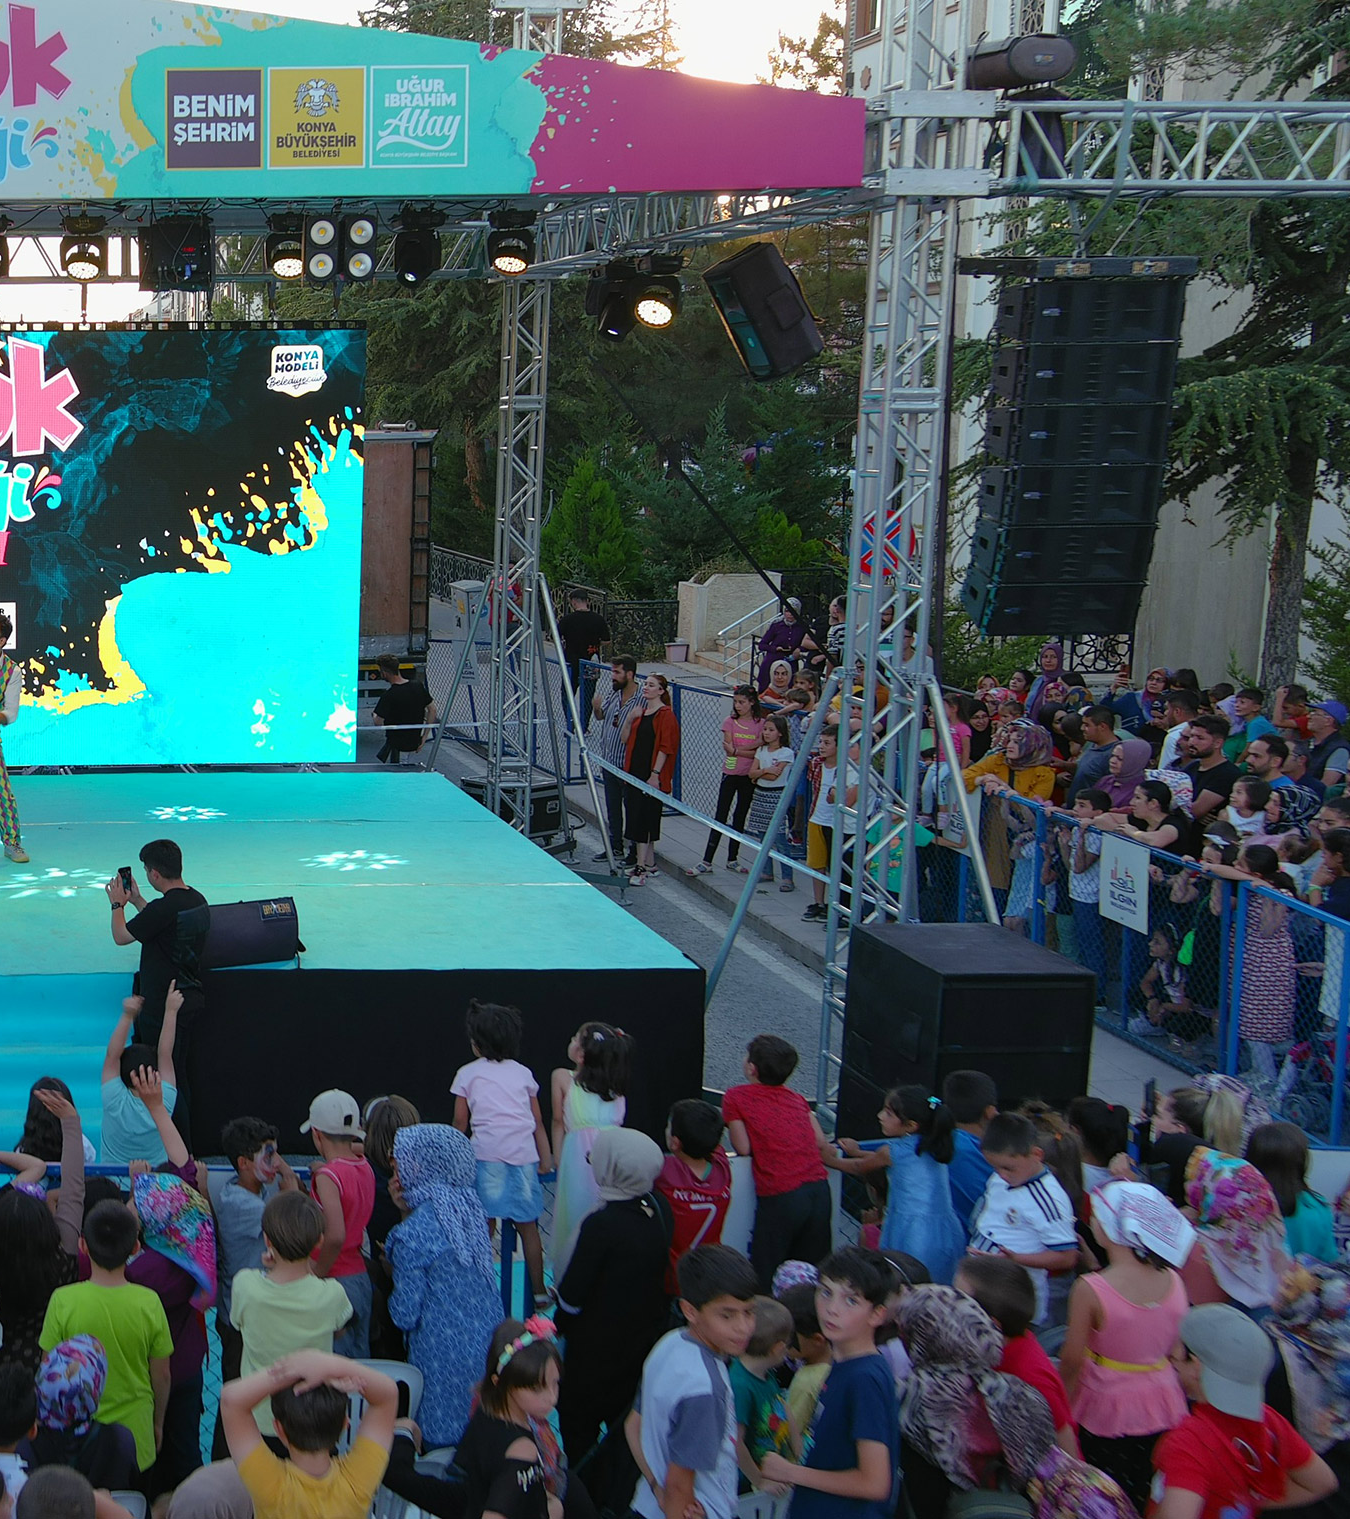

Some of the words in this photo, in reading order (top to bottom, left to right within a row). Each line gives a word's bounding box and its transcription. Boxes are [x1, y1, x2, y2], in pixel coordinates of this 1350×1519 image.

[396, 75, 445, 93] UĞUR
[173, 94, 255, 118] BENİM
[384, 92, 457, 107] İBRAHİM
[296, 122, 336, 133] KONYA
[378, 107, 462, 140] Altay
[173, 122, 255, 146] ŞEHRİM
[276, 132, 356, 149] BÜYÜKŞEHİR
[292, 149, 340, 159] BELEDİYESİ
[275, 350, 319, 363] KONYA
[274, 361, 319, 373] MODELİ
[690, 1202, 718, 1251] 7
